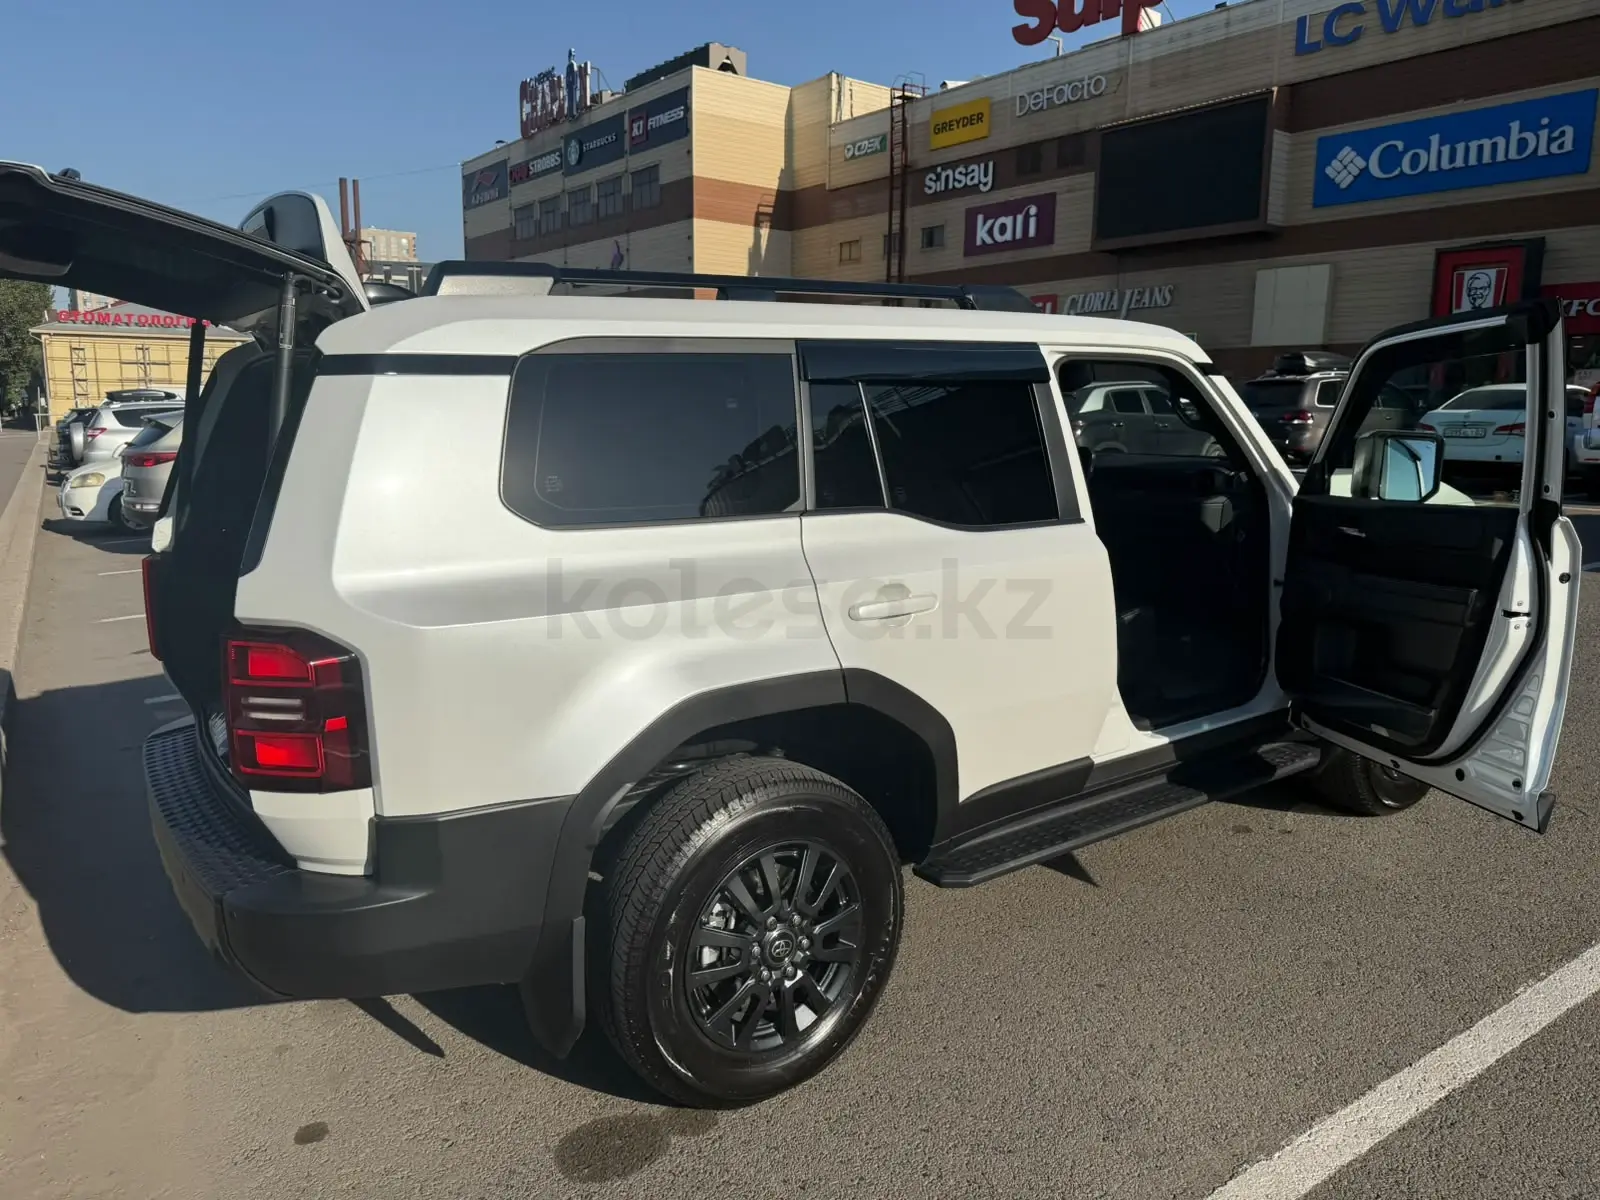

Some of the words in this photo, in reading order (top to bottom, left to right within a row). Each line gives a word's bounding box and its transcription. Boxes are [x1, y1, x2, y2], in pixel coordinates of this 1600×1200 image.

[1294, 3, 1366, 57] LC
[1016, 74, 1107, 118] DeFacto
[647, 105, 685, 130] FITNESS
[932, 111, 985, 136] GREYDER
[582, 132, 617, 152] STARBUCKS
[1368, 117, 1575, 179] Columbia
[528, 151, 561, 175] STROBBS
[924, 160, 994, 194] sinsay
[975, 204, 1039, 246] kari
[1119, 285, 1174, 319] JEANS
